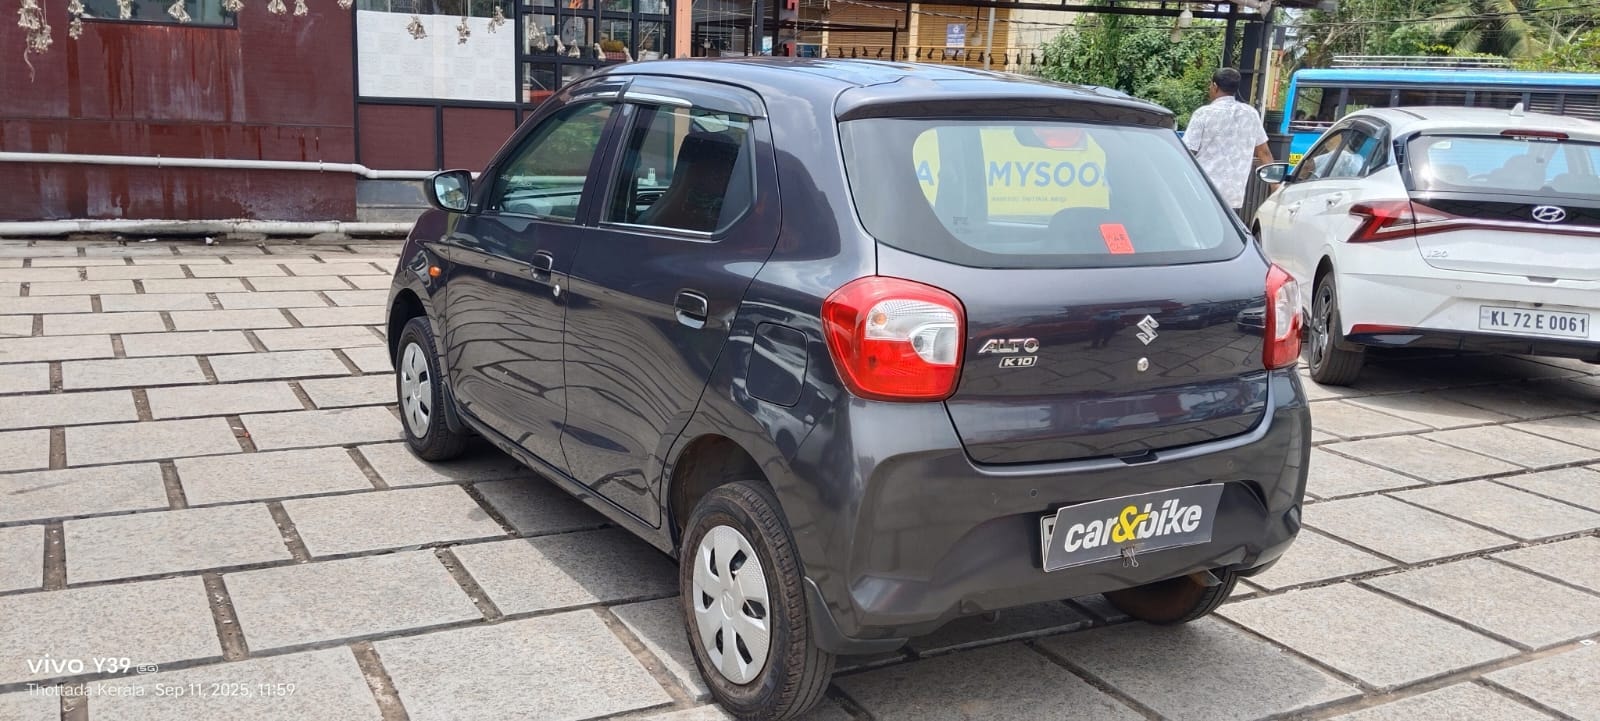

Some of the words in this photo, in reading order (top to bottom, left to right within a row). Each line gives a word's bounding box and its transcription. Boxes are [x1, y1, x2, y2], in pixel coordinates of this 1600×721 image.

[988, 161, 1106, 188] MYSOO
[1491, 310, 1508, 326] KL
[1513, 312, 1532, 328] 72
[1535, 314, 1544, 329] E
[1549, 315, 1585, 333] 0061
[978, 337, 1040, 354] ALTO
[1004, 357, 1033, 366] K10
[1064, 498, 1203, 553] car&bike
